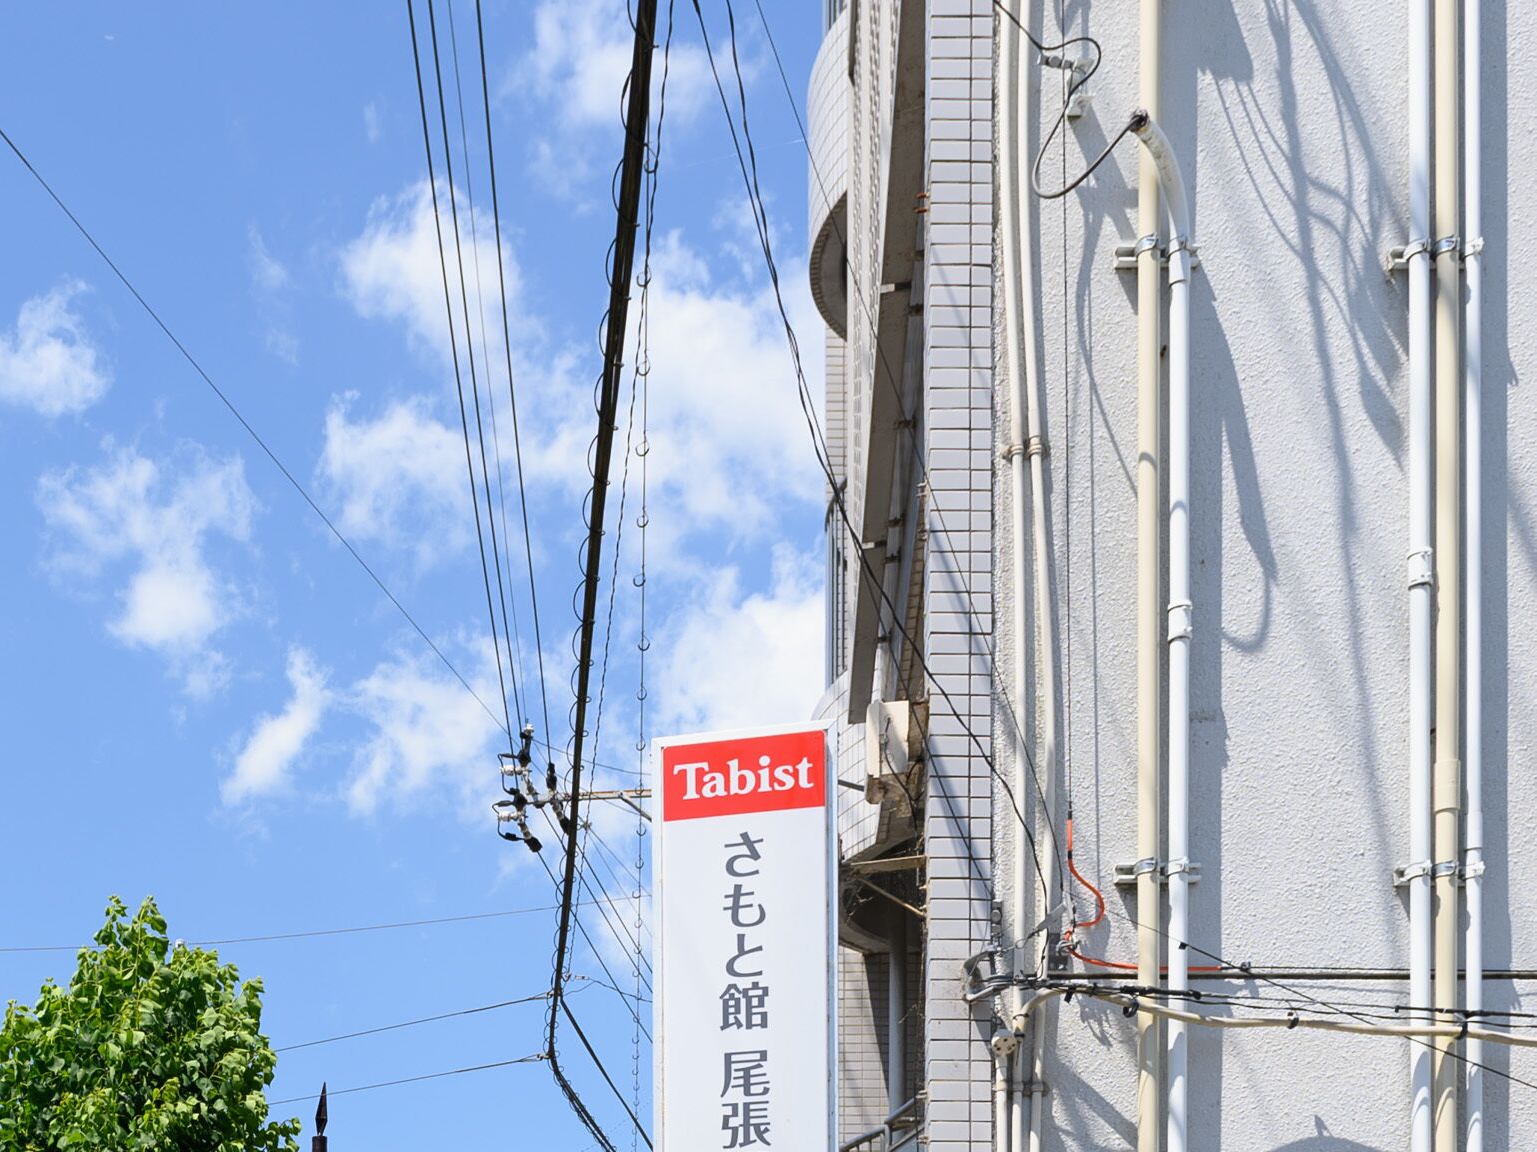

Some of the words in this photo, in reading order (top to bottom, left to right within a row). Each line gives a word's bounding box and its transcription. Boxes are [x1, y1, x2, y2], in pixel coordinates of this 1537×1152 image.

[673, 755, 815, 801] Tabist
[719, 831, 769, 1032] さもと館
